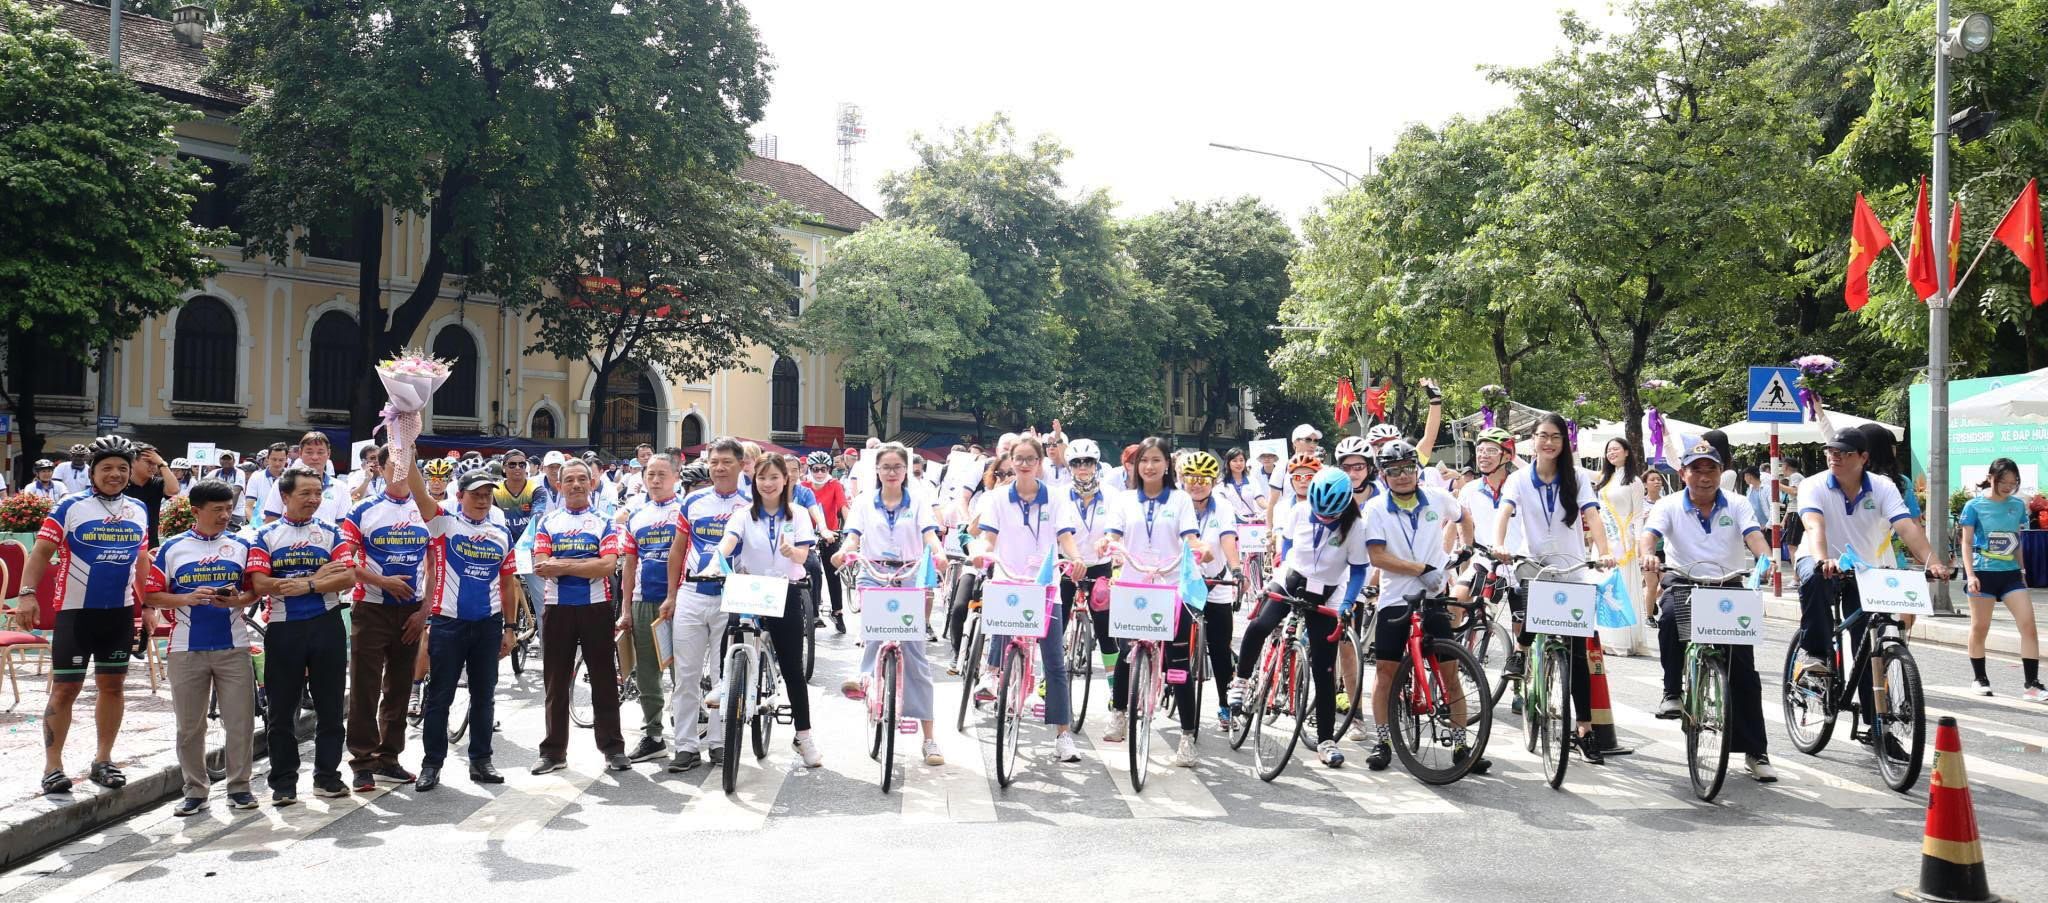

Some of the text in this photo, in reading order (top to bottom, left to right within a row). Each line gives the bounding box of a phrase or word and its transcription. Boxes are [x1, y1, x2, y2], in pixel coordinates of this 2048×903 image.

[82, 531, 97, 541] NỐI
[98, 532, 116, 541] VÒNG
[116, 534, 129, 542] TAY
[386, 536, 403, 545] VÒNG
[404, 537, 416, 545] TAY
[302, 557, 314, 565] TAY
[178, 572, 191, 584] NỐI
[192, 573, 212, 582] VÒNG
[213, 572, 226, 581] TAY
[1866, 597, 1926, 609] Vietcombank
[986, 618, 1040, 629] Vietcombank
[1113, 621, 1169, 633] Vietcombank
[1531, 616, 1589, 629] Vietcombank
[865, 624, 920, 634] Vietcombank
[1697, 625, 1757, 637] Vietcombank
